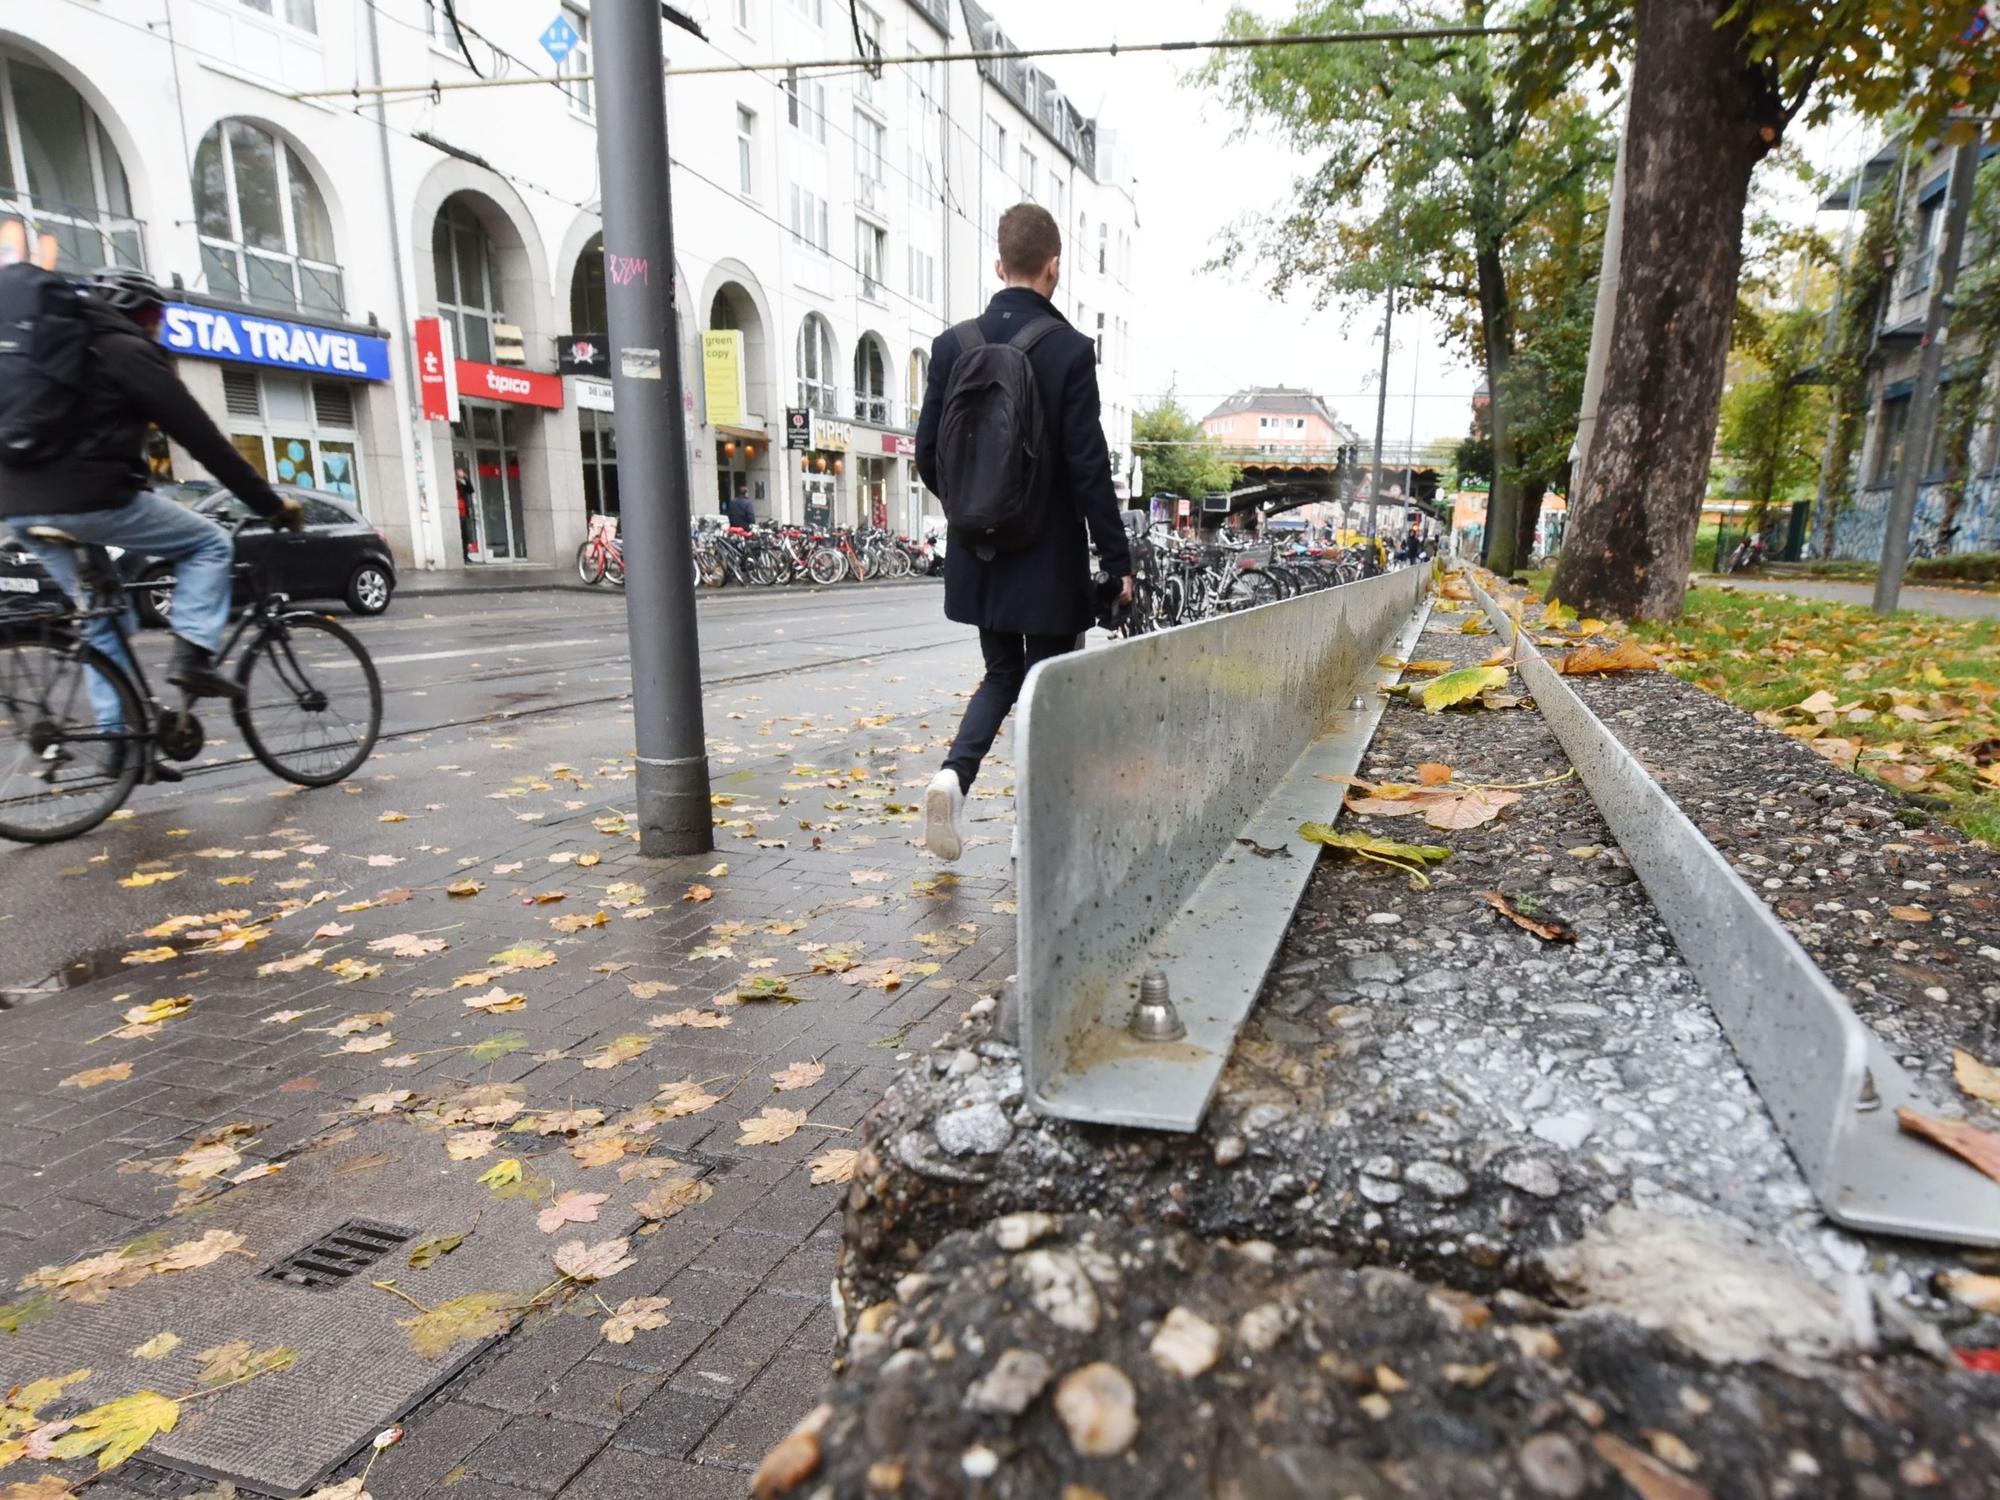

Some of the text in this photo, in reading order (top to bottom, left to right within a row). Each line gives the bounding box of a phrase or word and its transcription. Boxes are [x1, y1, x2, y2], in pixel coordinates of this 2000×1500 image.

[166, 307, 367, 373] STA TRAVEL
[705, 336, 732, 347] green
[706, 350, 729, 359] copy
[486, 369, 530, 394] tipico
